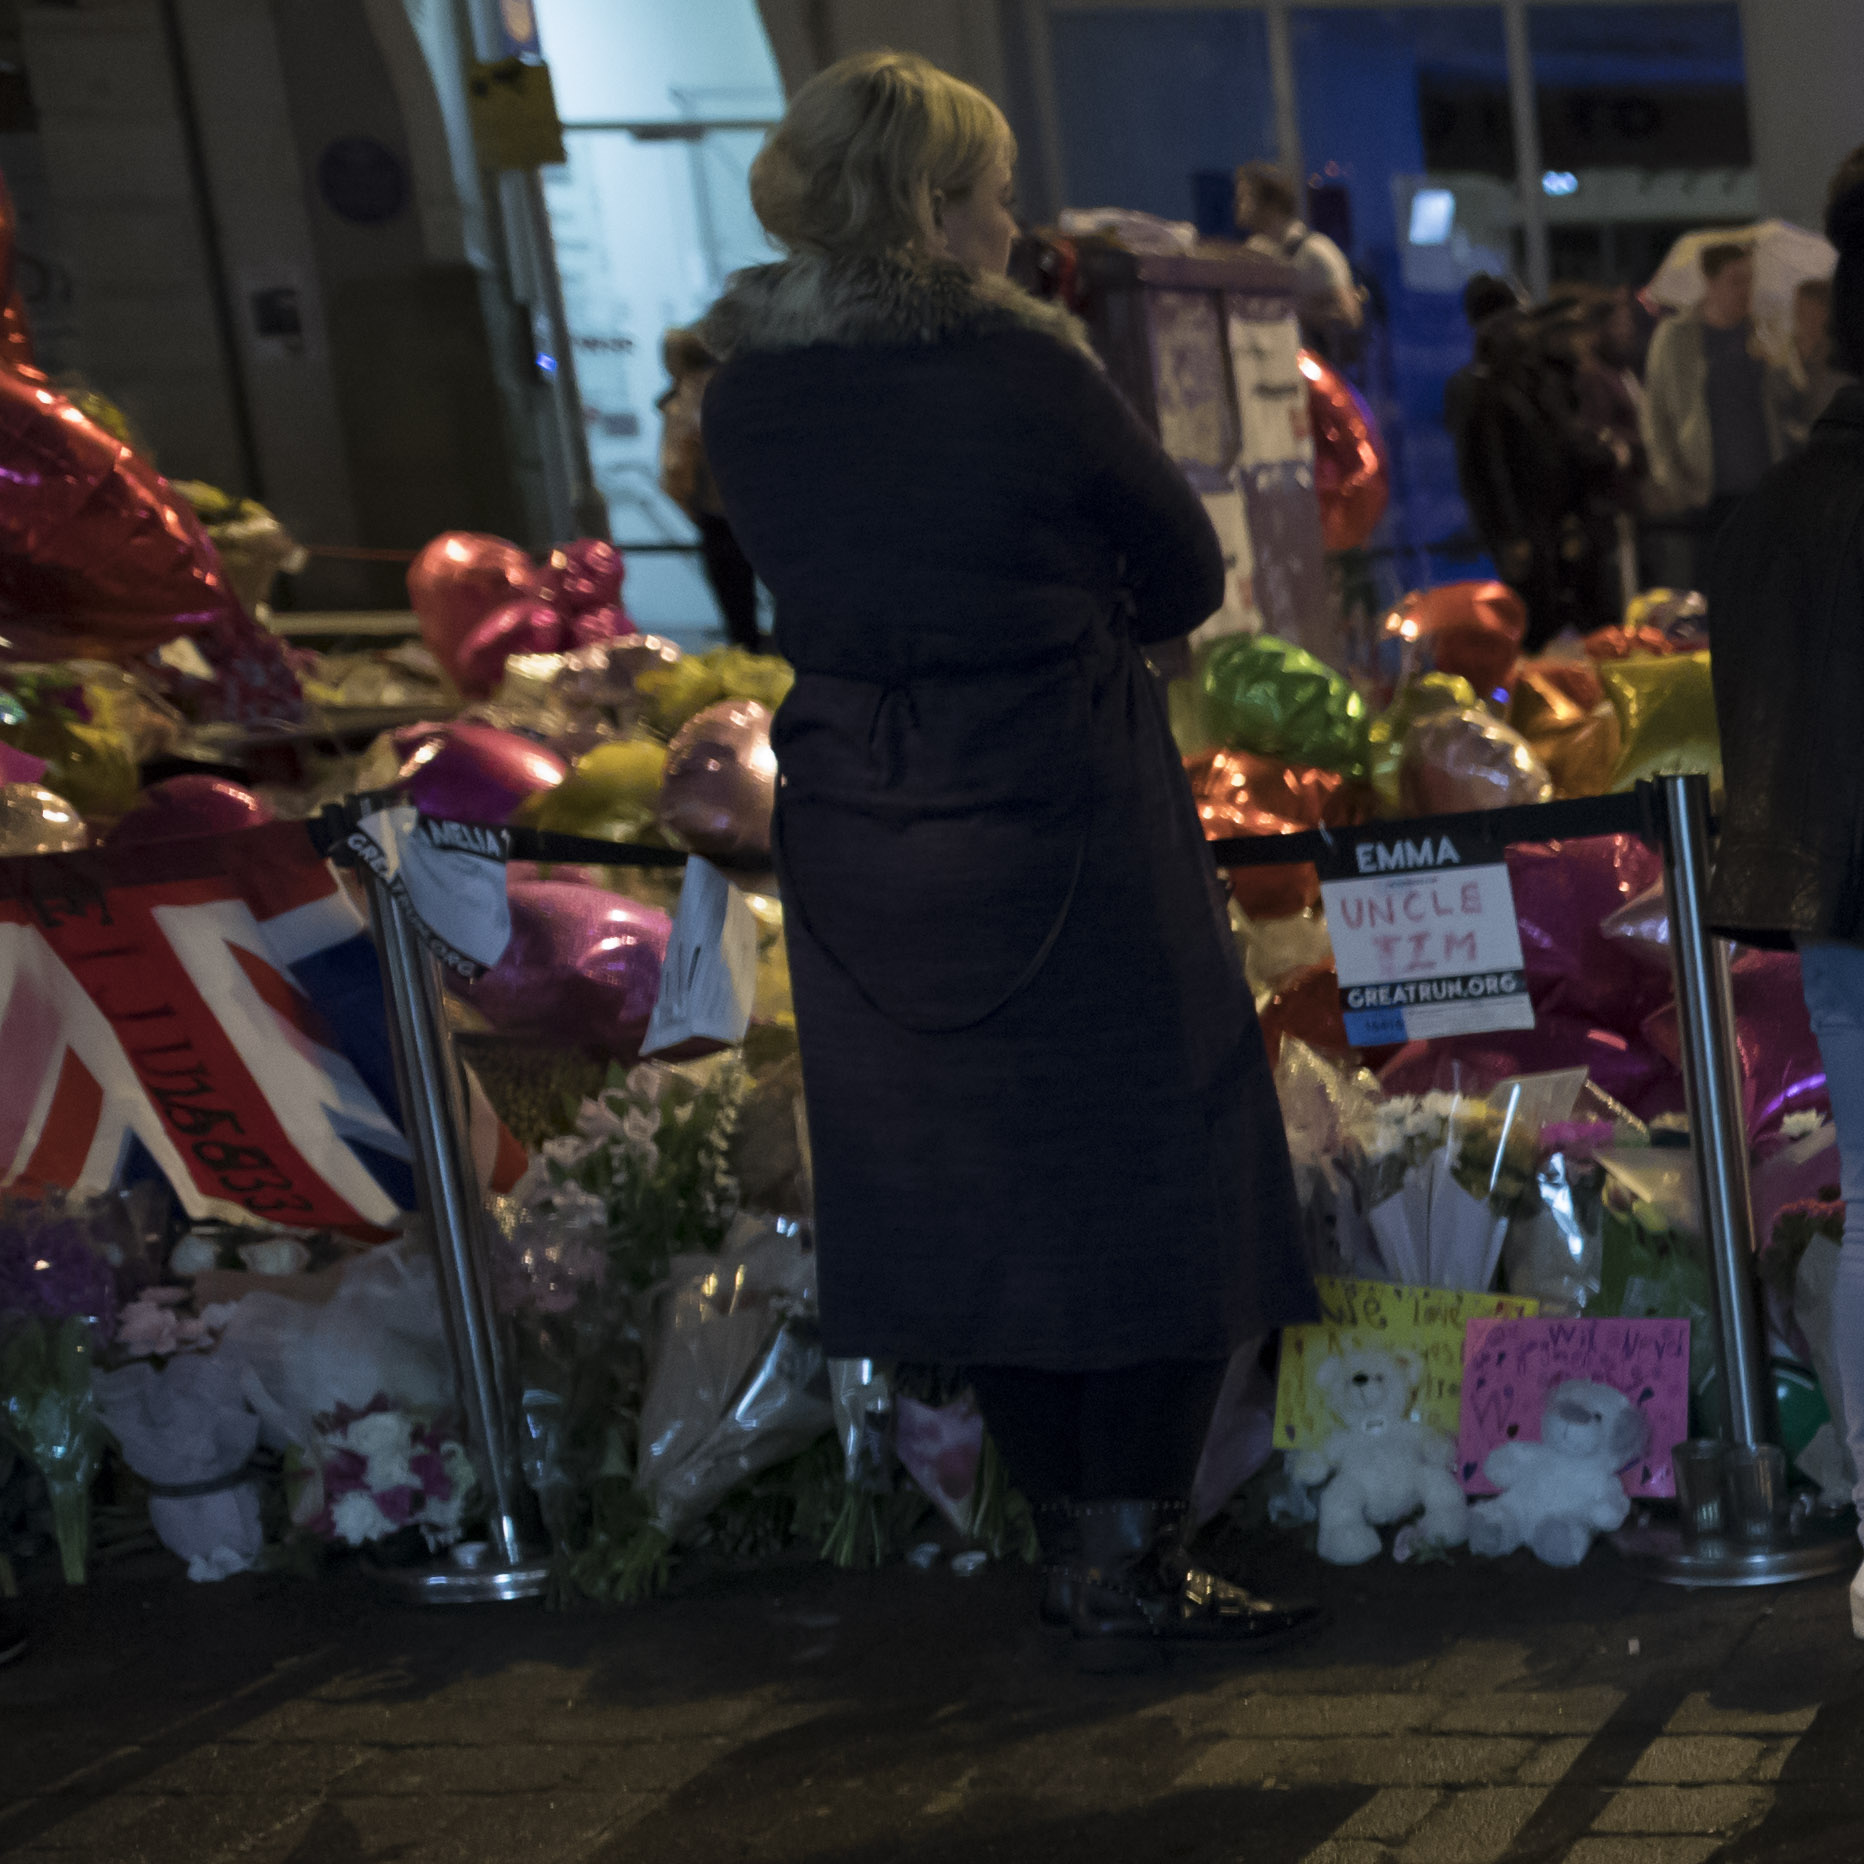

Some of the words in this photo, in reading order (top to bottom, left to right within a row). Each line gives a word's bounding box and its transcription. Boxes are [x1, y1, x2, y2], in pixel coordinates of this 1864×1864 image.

[1355, 835, 1461, 873] EMMA
[1340, 881, 1483, 930] UNCLE
[1372, 931, 1478, 978] TIM
[1347, 972, 1518, 1009] GREATRUN.ORG
